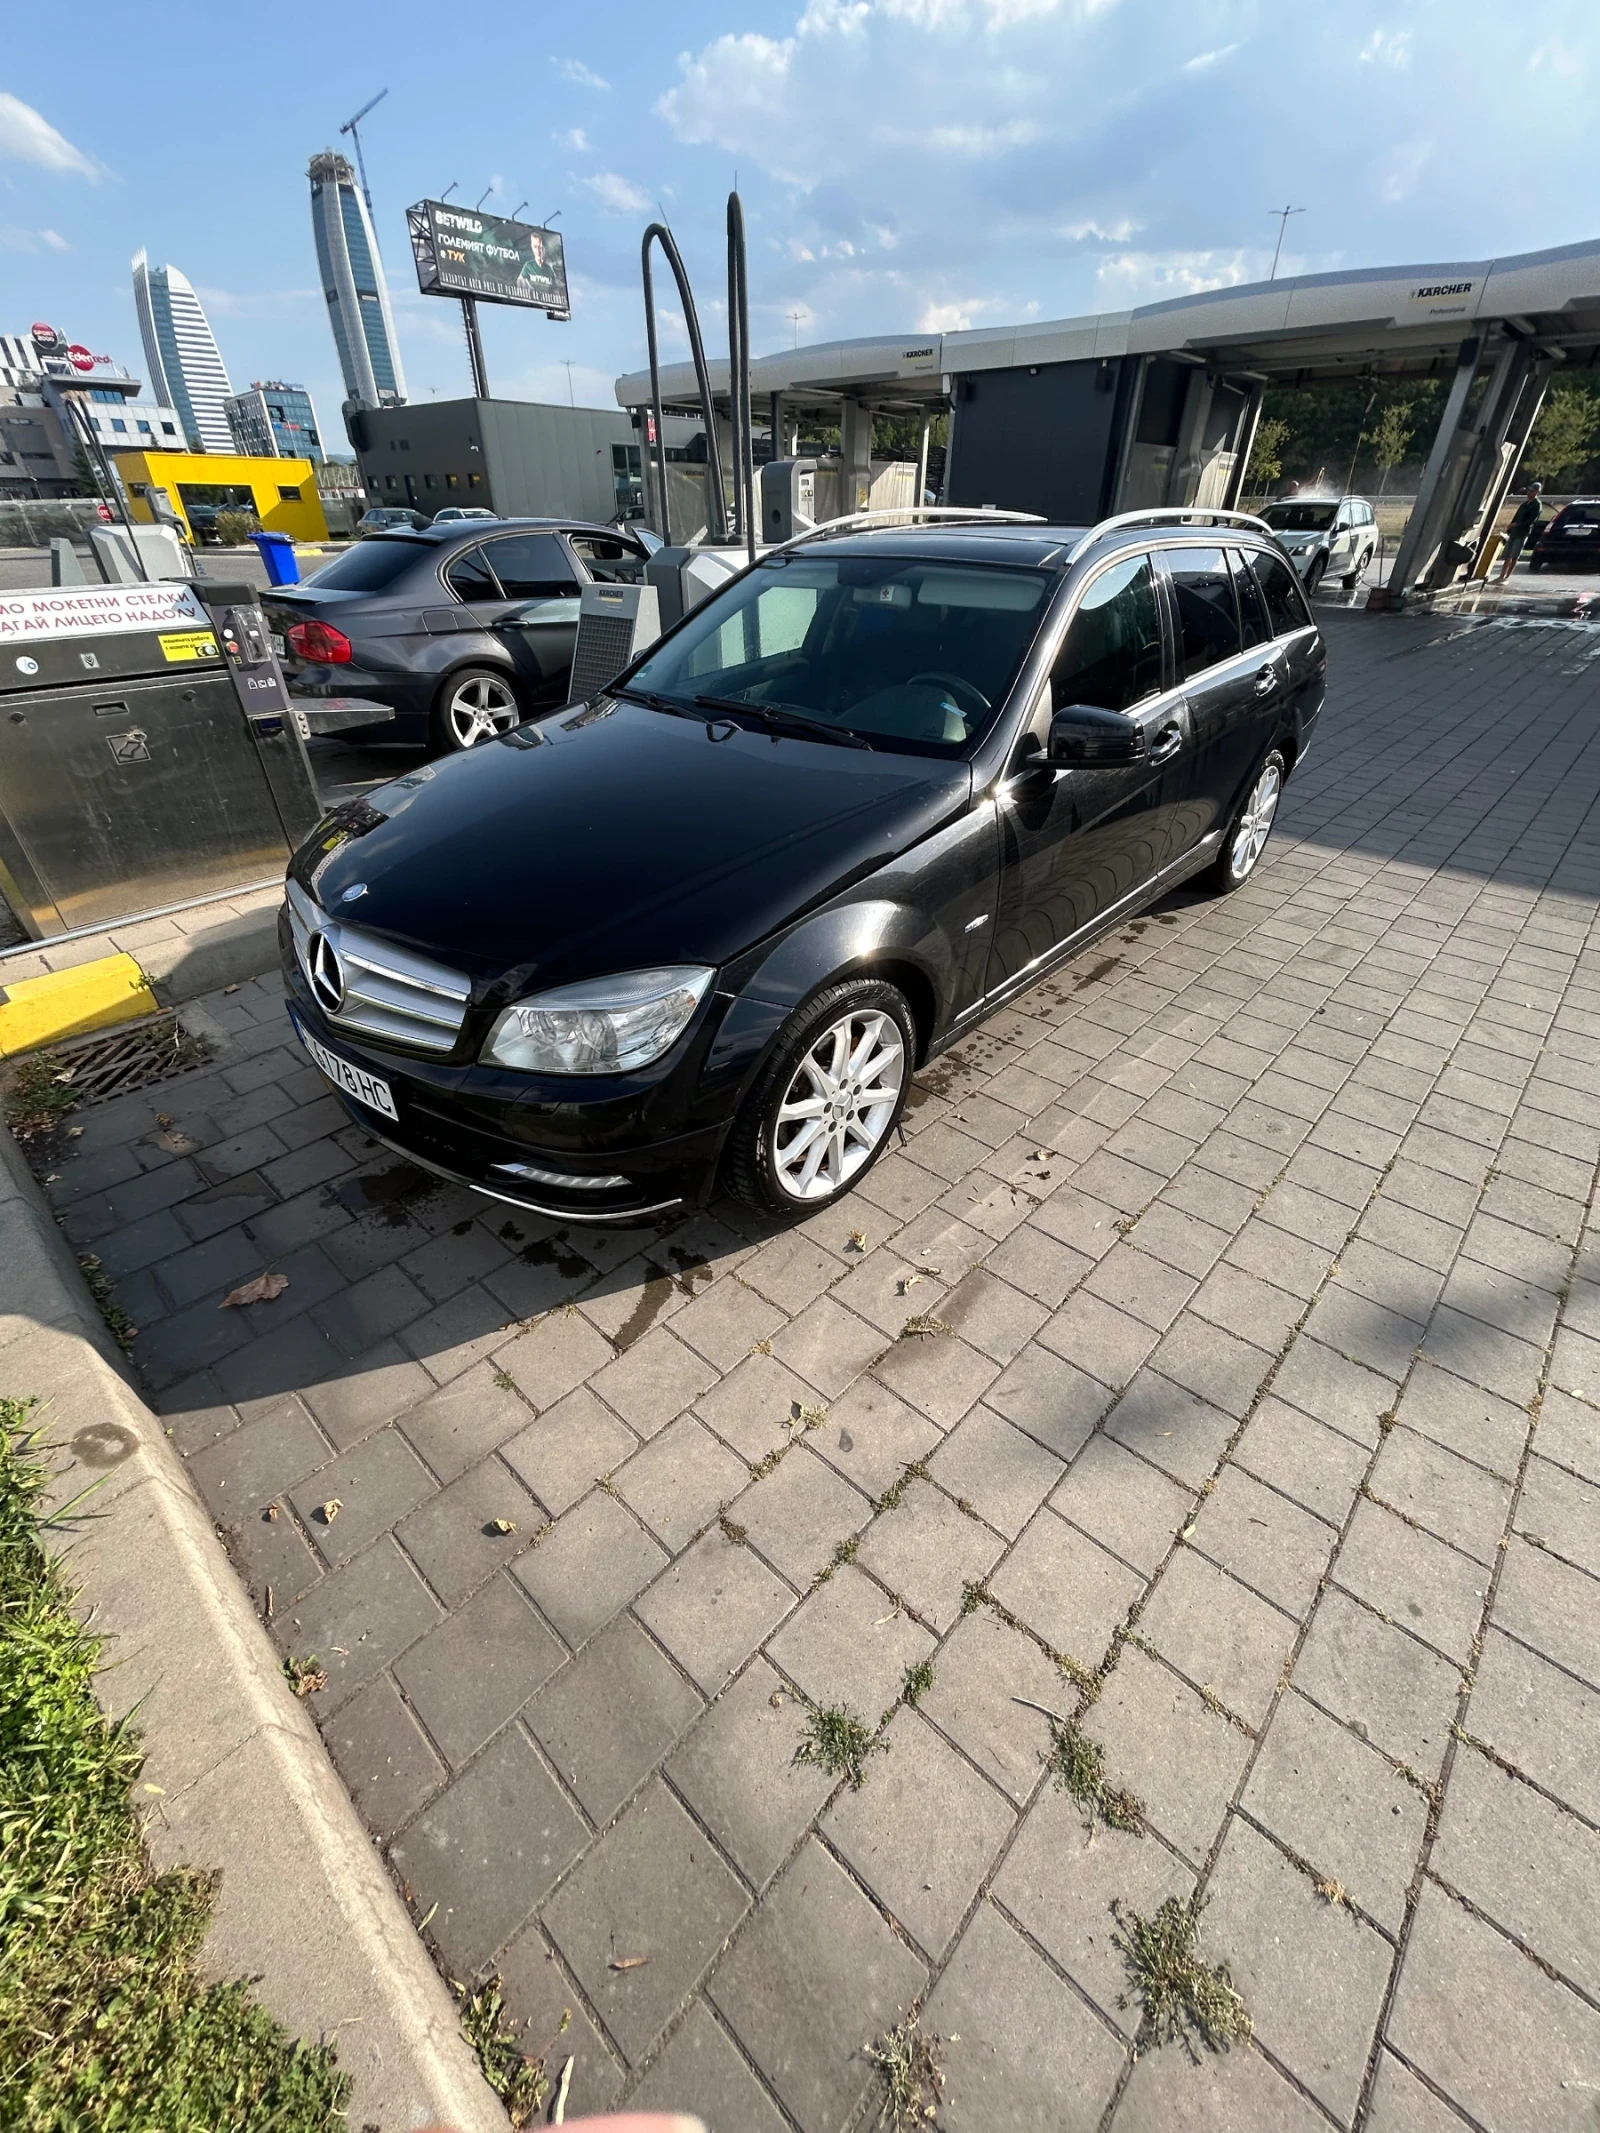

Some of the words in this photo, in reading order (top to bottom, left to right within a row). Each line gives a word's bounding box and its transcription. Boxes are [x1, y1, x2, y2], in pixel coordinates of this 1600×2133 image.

[435, 209, 483, 234] BETWILD
[437, 232, 485, 254] ГОЛЕМИЯТ
[485, 243, 520, 262] ФУТБОЛ
[447, 249, 466, 264] ТУК
[1417, 282, 1473, 298] KÄRCHER
[67, 351, 110, 364] Edenred
[32, 597, 120, 612] МОКЕТНИ
[125, 592, 190, 606] СТЕЛКИ
[0, 616, 50, 632] АГАЙ
[55, 613, 122, 628] ЛИЦЕТО
[125, 607, 196, 622] НАДОЛУ
